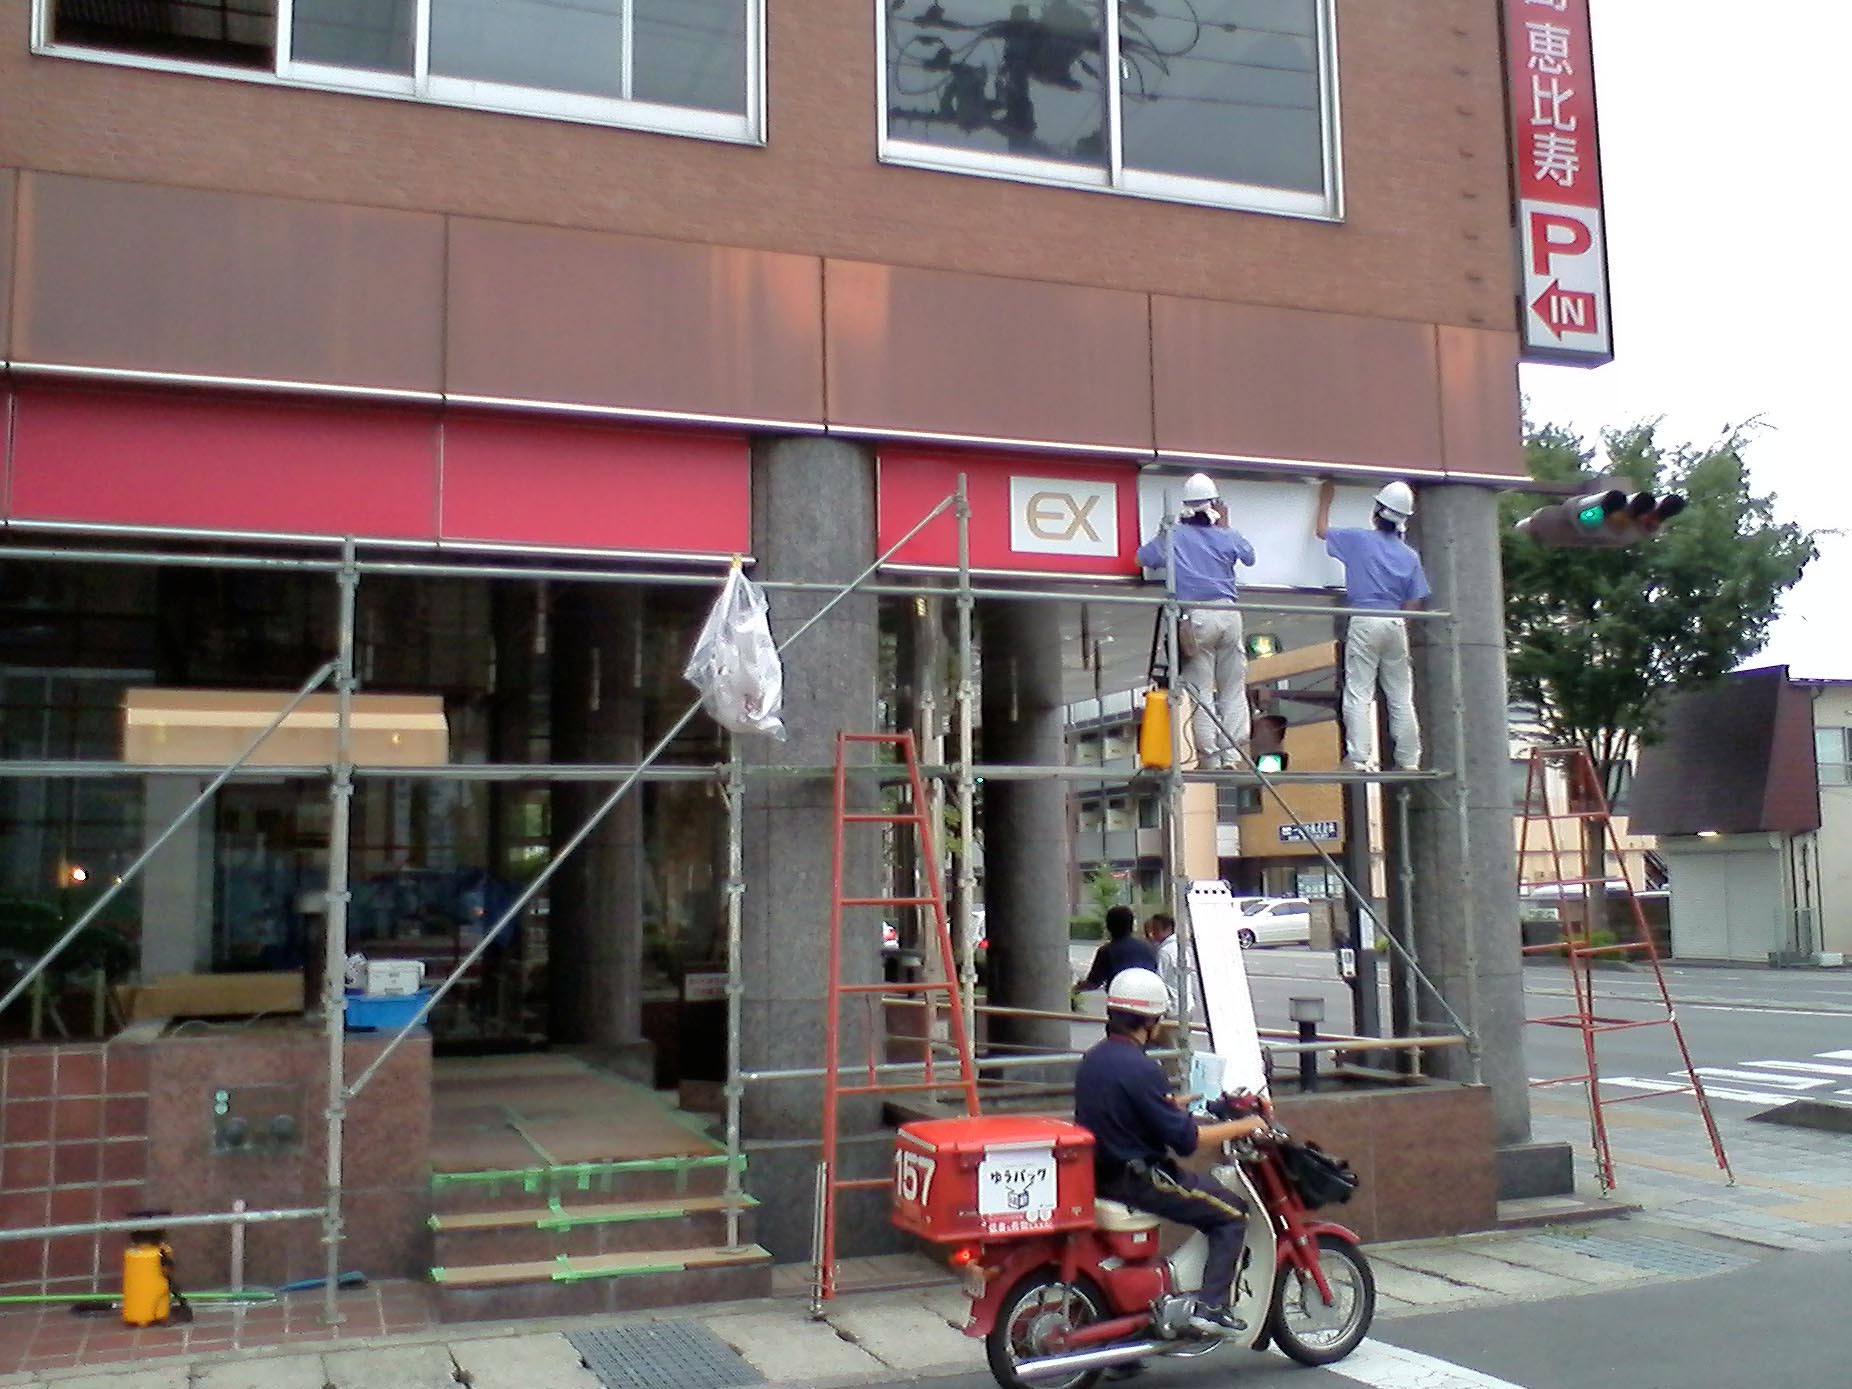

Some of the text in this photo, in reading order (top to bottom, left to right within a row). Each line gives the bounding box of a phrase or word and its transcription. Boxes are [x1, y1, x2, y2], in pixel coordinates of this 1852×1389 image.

[1524, 0, 1580, 187] 恵比寿
[1530, 211, 1591, 276] P
[1551, 295, 1585, 327] IN
[1027, 491, 1101, 543] EX
[896, 1149, 936, 1207] 157
[990, 1168, 1047, 1184] ゆうパック
